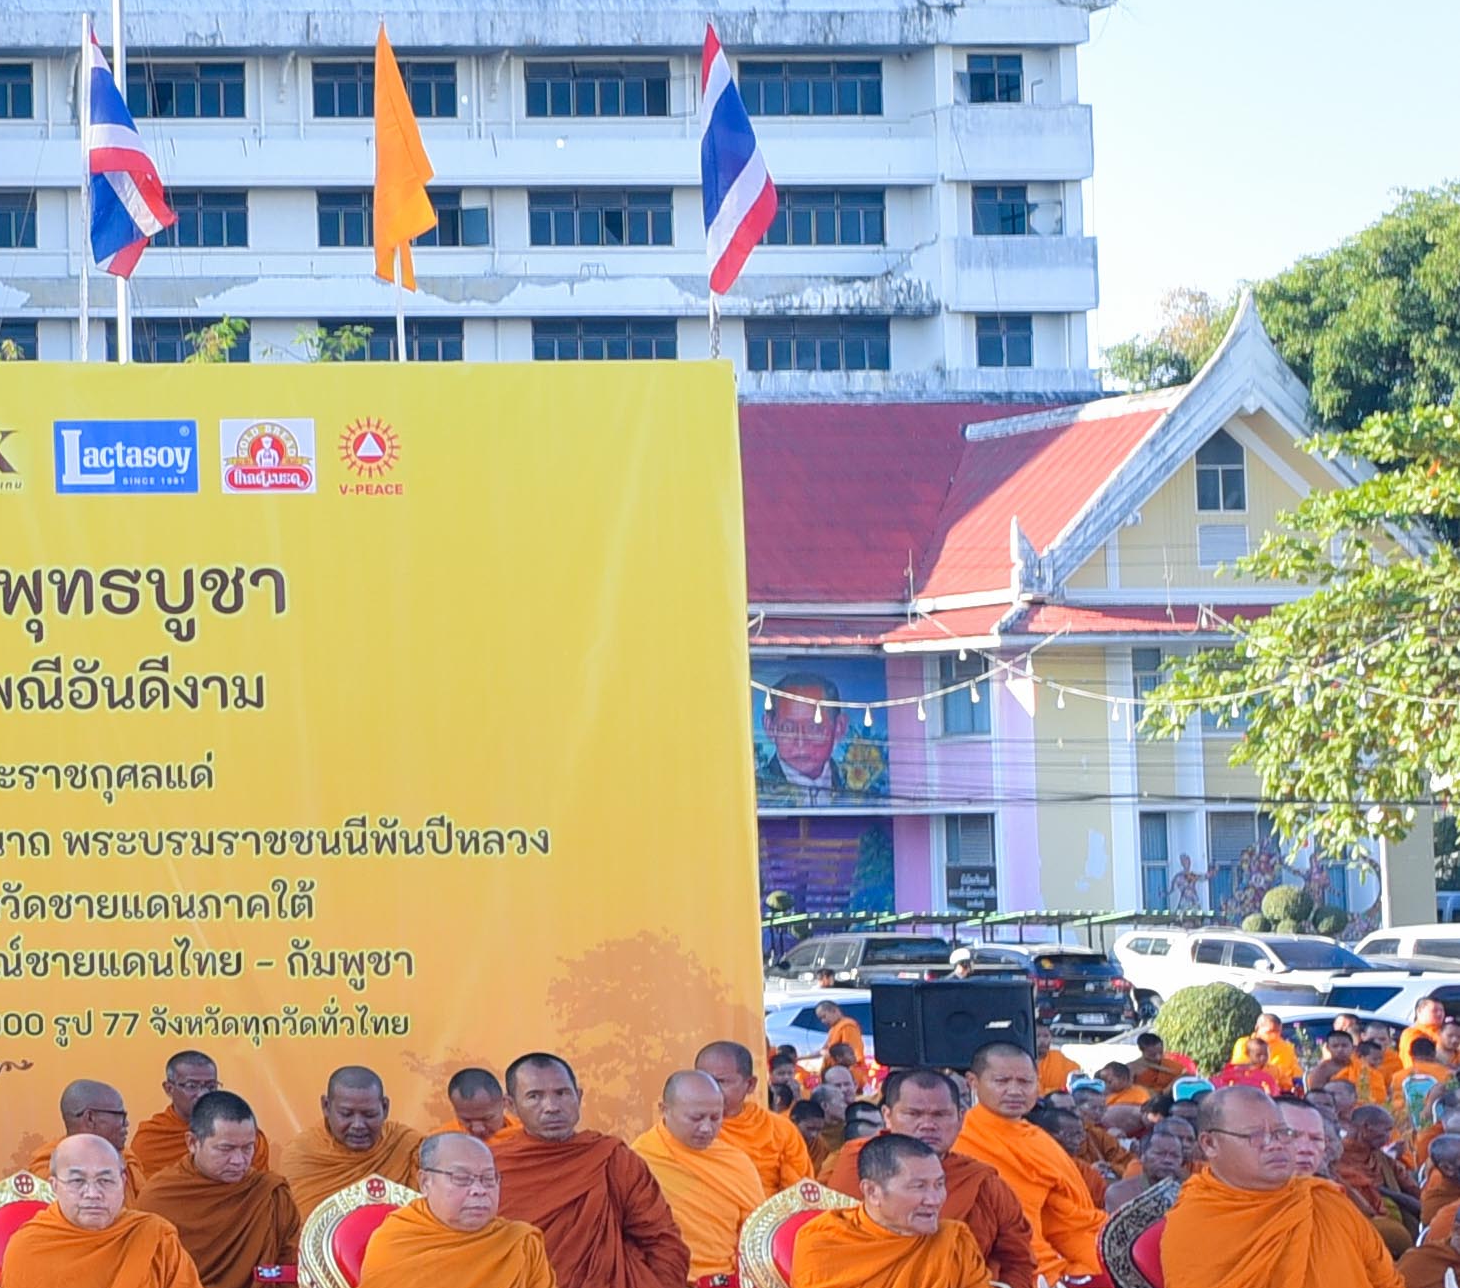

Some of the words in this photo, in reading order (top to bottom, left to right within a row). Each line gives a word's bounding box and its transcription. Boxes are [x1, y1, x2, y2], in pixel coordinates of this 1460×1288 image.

[60, 428, 193, 486] Lactasoy
[122, 477, 156, 486] SINCE
[338, 484, 404, 497] V-PEACE
[62, 815, 549, 856] พระบรมราชชนนีพันปีหลวง
[287, 938, 413, 991] กัมพูชา
[53, 1010, 92, 1048] รูป
[102, 1013, 139, 1036] 77
[149, 999, 409, 1046] จังหวัดทุกวัดทั่วไทย
